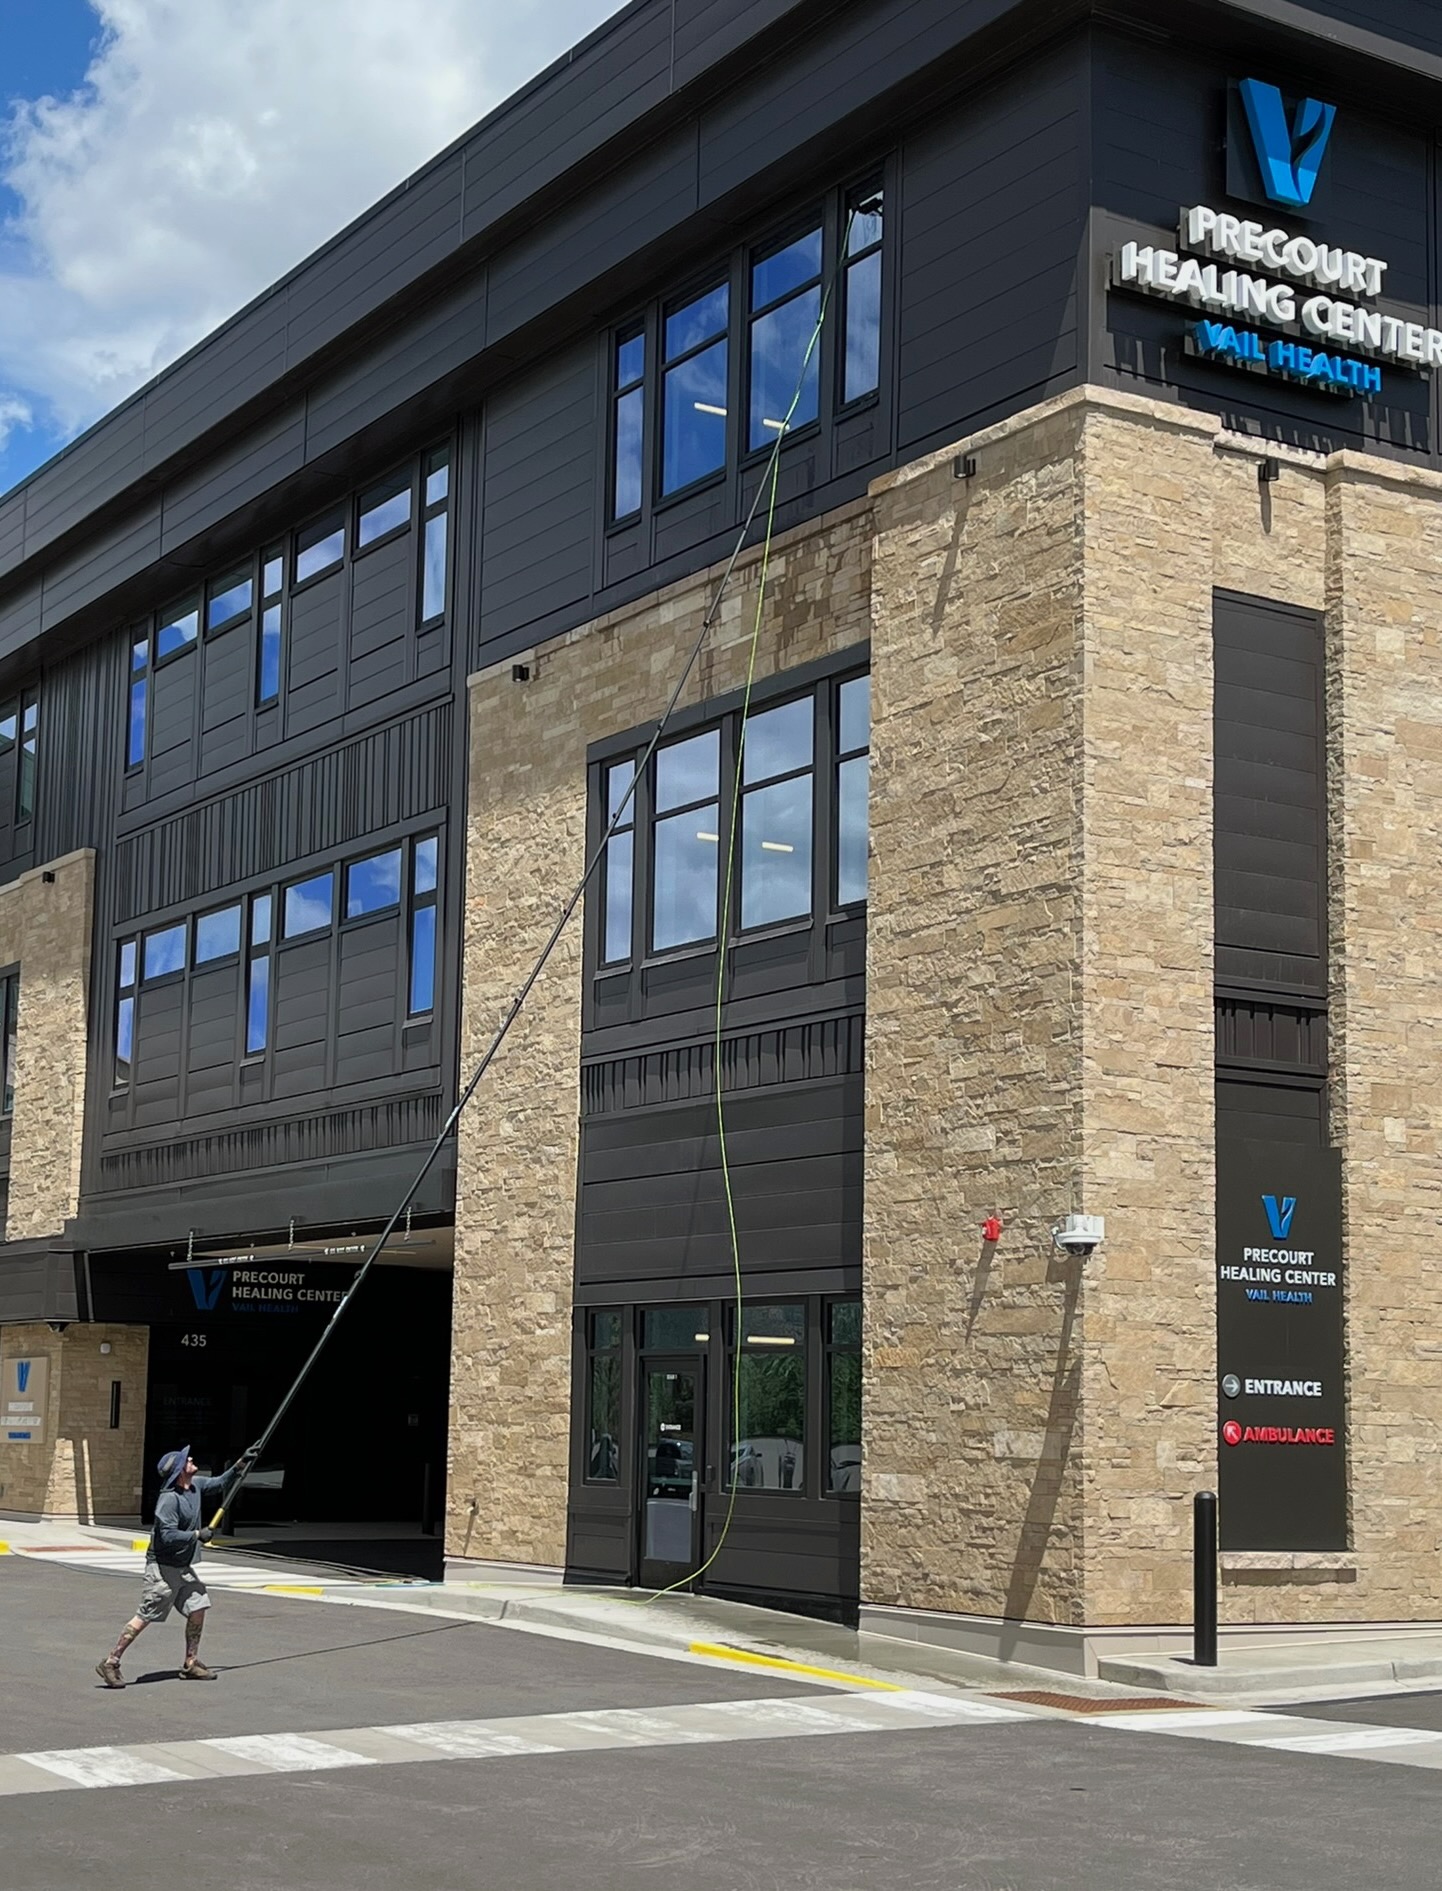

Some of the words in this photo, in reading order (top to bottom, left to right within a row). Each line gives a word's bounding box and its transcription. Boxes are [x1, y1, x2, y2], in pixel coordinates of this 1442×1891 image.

[1188, 205, 1387, 296] PRECOURT
[1121, 241, 1295, 324] HEALING
[1301, 296, 1442, 368] CENTER
[1195, 319, 1265, 363] VAIL
[1269, 340, 1382, 394] HEALTH
[1243, 1247, 1314, 1266] PRECOURT
[232, 1270, 306, 1285] PRECOURT
[1220, 1265, 1281, 1283] HEALING
[1284, 1270, 1336, 1287] CENTER
[232, 1286, 293, 1300] HEALING
[1245, 1288, 1270, 1302] VAIL
[1272, 1289, 1313, 1304] HEALTH
[180, 1333, 207, 1348] 435
[1244, 1378, 1322, 1397] ENTRANCE
[1242, 1425, 1335, 1445] AMBULANCE
